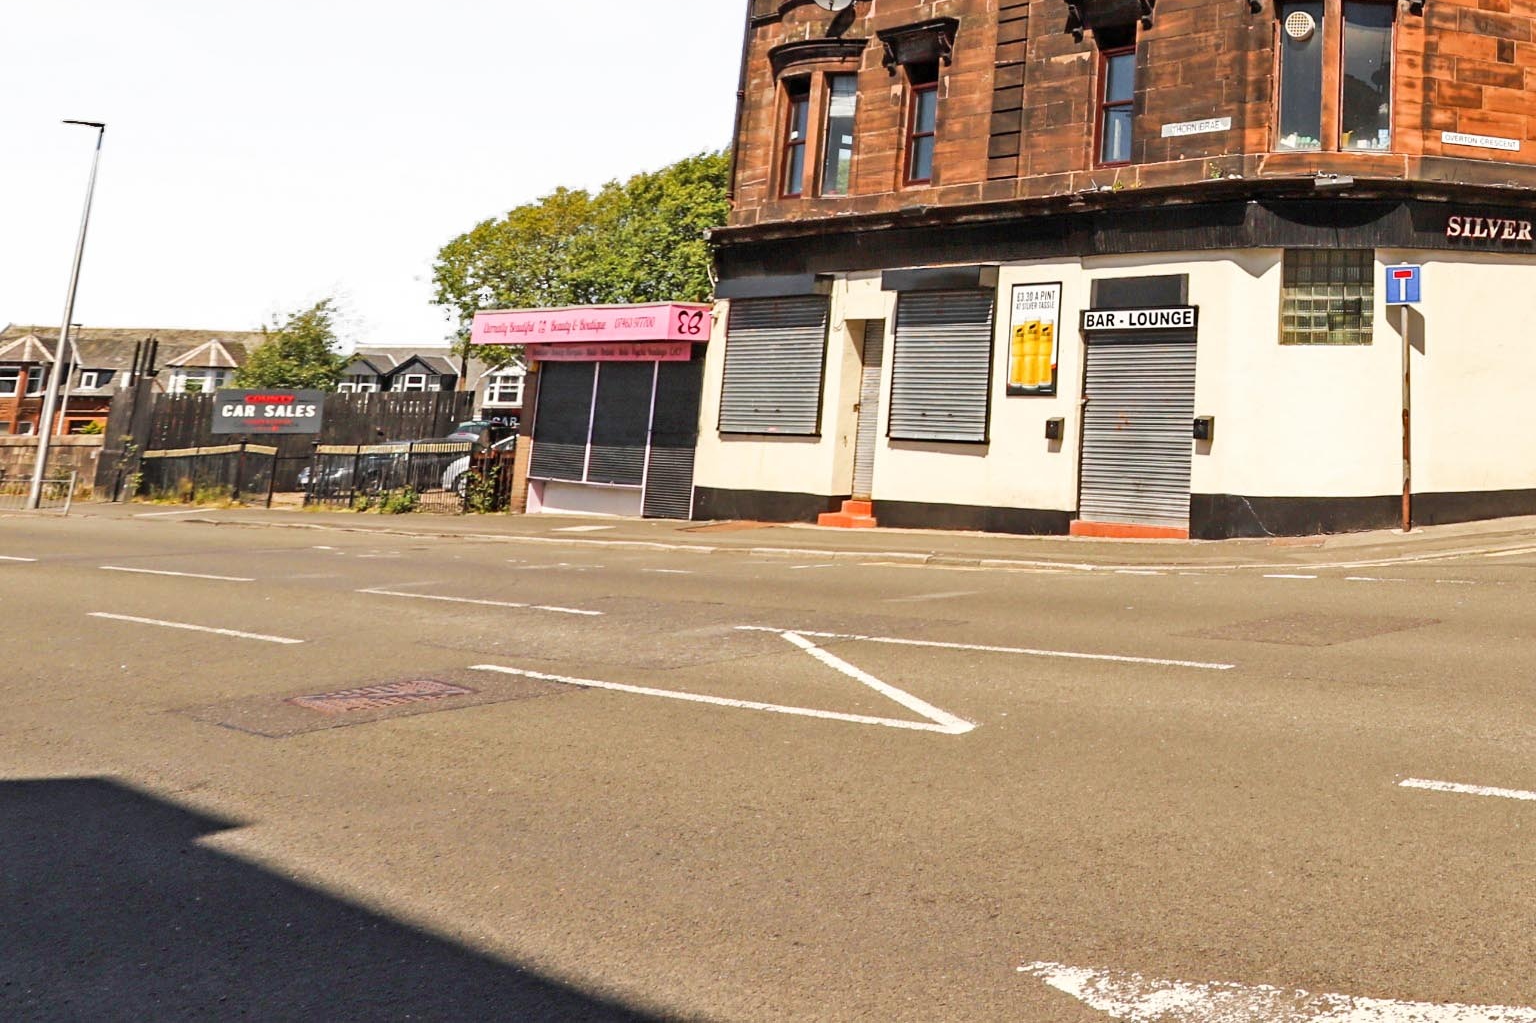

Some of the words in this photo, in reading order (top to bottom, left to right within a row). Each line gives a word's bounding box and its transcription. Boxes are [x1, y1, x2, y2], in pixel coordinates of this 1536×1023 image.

[1199, 120, 1220, 131] BRAE
[1445, 134, 1478, 144] OVERTON
[1480, 138, 1516, 148] CRESCENT
[1446, 216, 1533, 241] SILVER
[1040, 290, 1055, 300] PINT
[1086, 313, 1115, 327] BAR
[1128, 310, 1192, 327] LOUNGE
[221, 405, 256, 418] CAR
[263, 405, 316, 418] SALES
